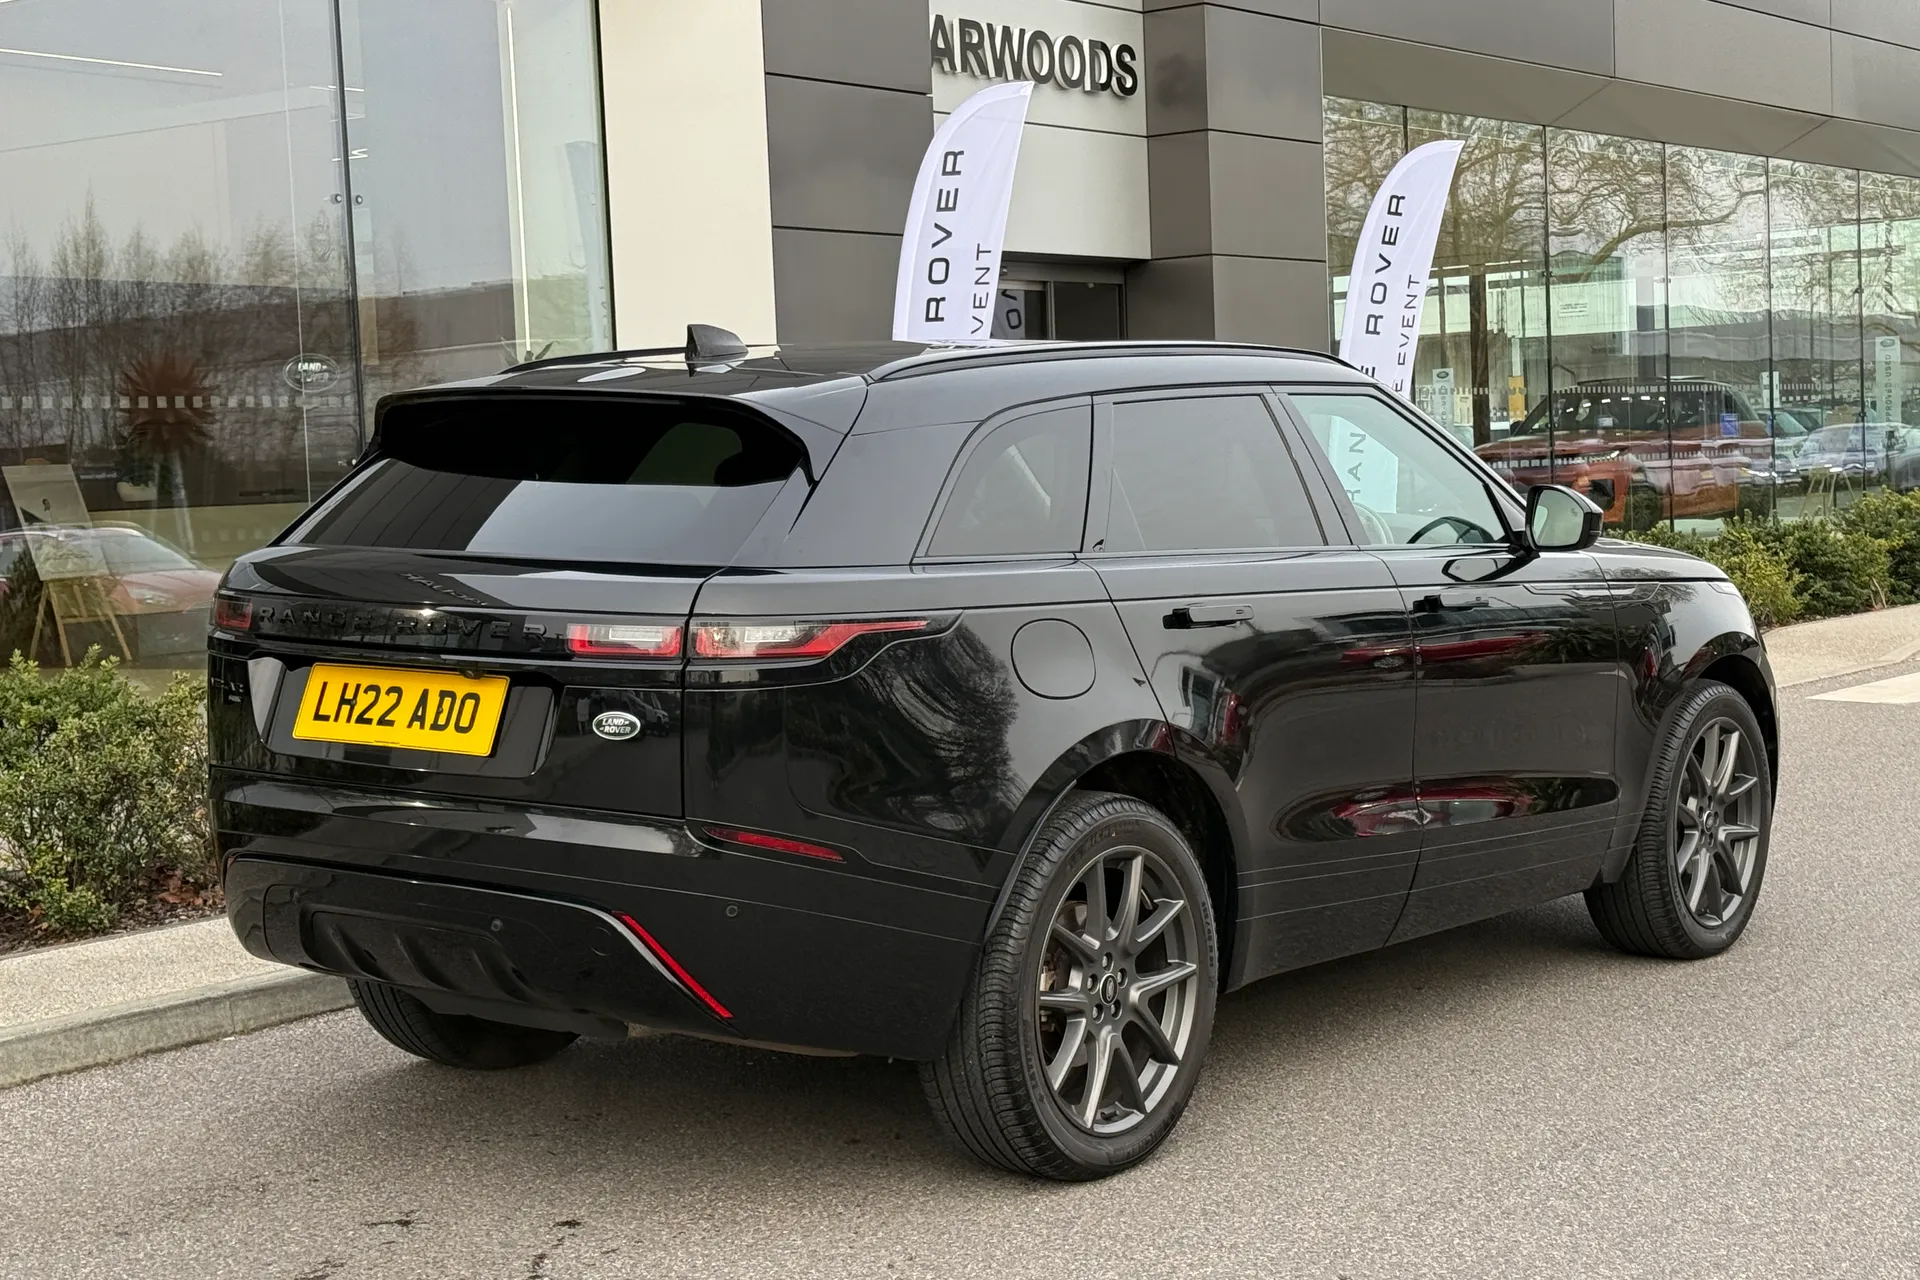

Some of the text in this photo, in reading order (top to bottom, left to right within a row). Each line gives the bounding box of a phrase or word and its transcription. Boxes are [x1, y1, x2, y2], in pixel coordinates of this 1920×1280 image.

[931, 14, 1139, 98] ARWOODS
[924, 149, 965, 323] ROVER
[1365, 193, 1406, 336] ROVER
[970, 242, 992, 335] VENT
[1397, 273, 1421, 366] EVENT
[256, 606, 549, 645] RANGE ROVER
[312, 679, 481, 735] LH22 ADO
[602, 717, 624, 725] LAND
[604, 725, 631, 734] ROVER
